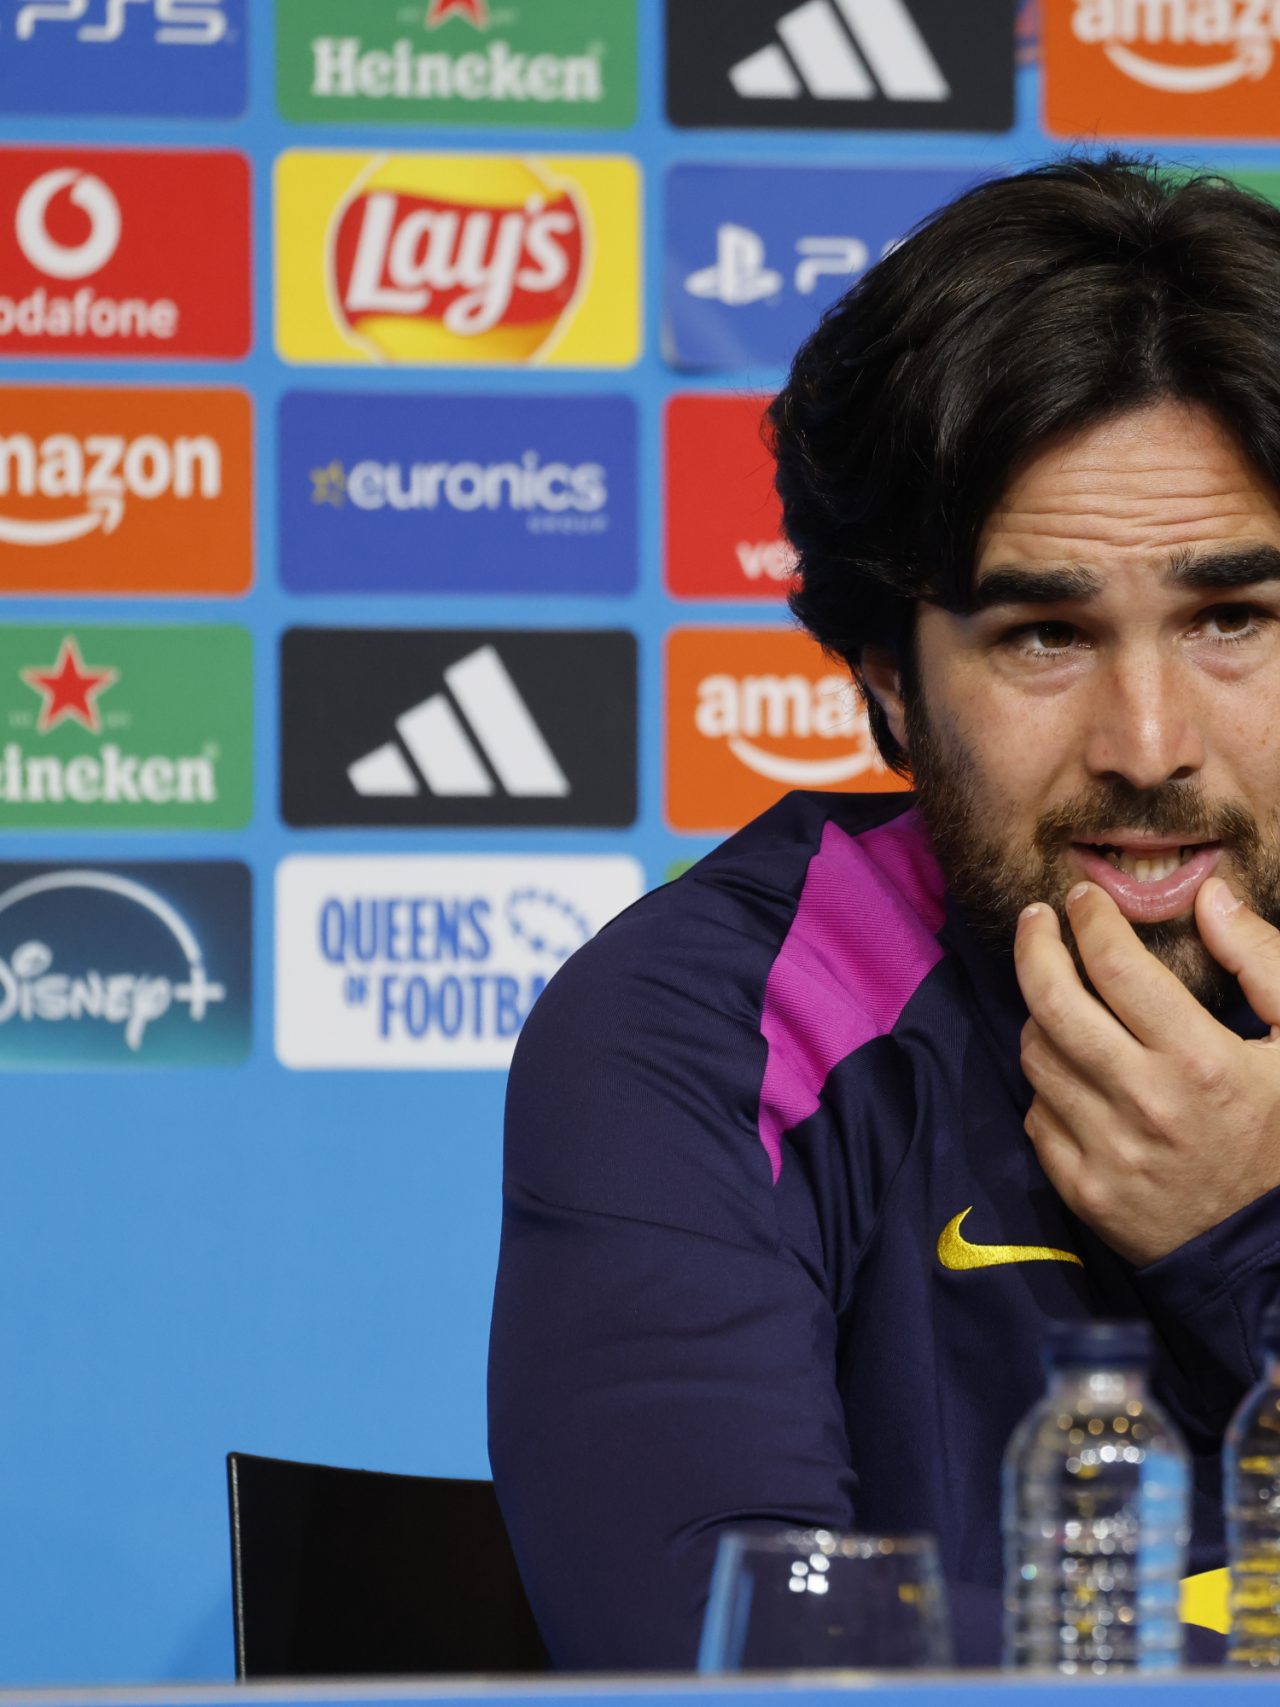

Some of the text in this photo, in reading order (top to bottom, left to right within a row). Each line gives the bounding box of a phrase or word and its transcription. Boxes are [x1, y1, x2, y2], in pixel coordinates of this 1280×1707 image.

[312, 36, 603, 102] Heineken
[346, 190, 575, 336] Lay's
[346, 450, 608, 512] euronics
[694, 674, 869, 740] ama
[317, 896, 491, 966] QUEENS
